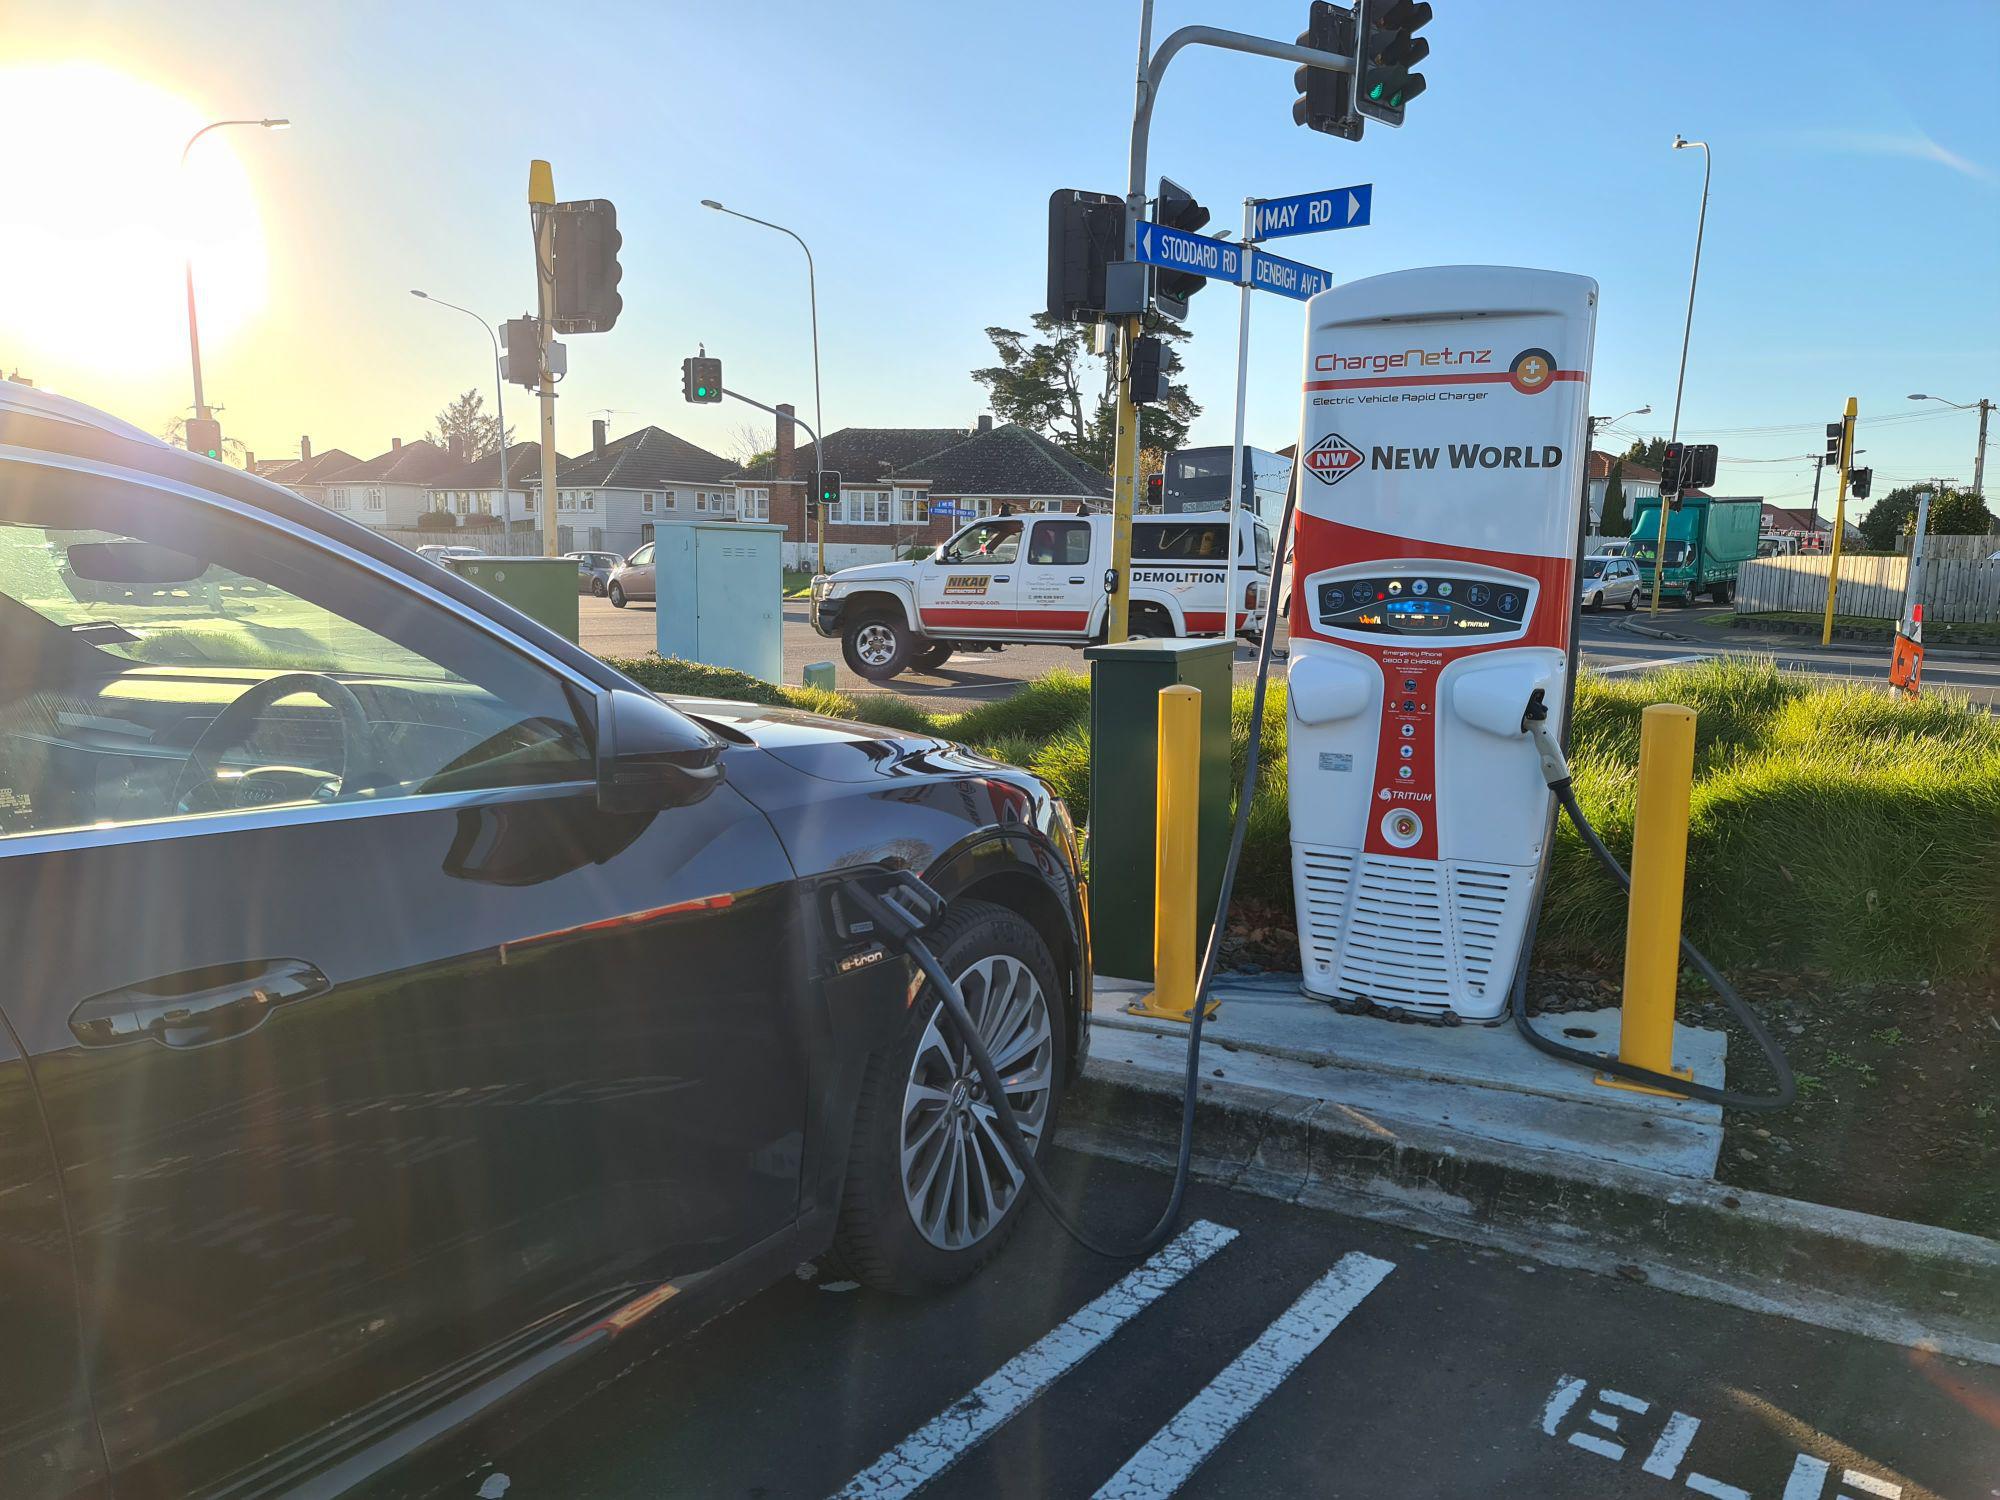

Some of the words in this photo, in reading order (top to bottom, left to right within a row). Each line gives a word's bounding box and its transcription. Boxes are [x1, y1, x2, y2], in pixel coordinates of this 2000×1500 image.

[1265, 203, 1299, 231] MAY
[1308, 199, 1332, 225] RD
[1161, 235, 1218, 269] STODDARD
[1222, 251, 1237, 274] RD
[1256, 259, 1297, 291] DENBIGH
[1300, 273, 1319, 295] AVE
[1315, 347, 1492, 373] ChargeNet.nz
[1313, 396, 1355, 406] Electric
[1358, 394, 1399, 404] Vehicle
[1401, 392, 1436, 404] Rapid
[1439, 391, 1489, 402] Charger
[1316, 451, 1349, 467] NW
[1371, 445, 1440, 471] NEW
[1448, 443, 1563, 471] WORLD
[948, 576, 988, 587] NIKAU
[1133, 572, 1226, 583] DEMOLITION
[935, 599, 1000, 607] www.nikaugroup.com
[1383, 650, 1420, 658] Emergency
[1392, 790, 1432, 801] TRITIUM
[841, 952, 883, 969] e-tron
